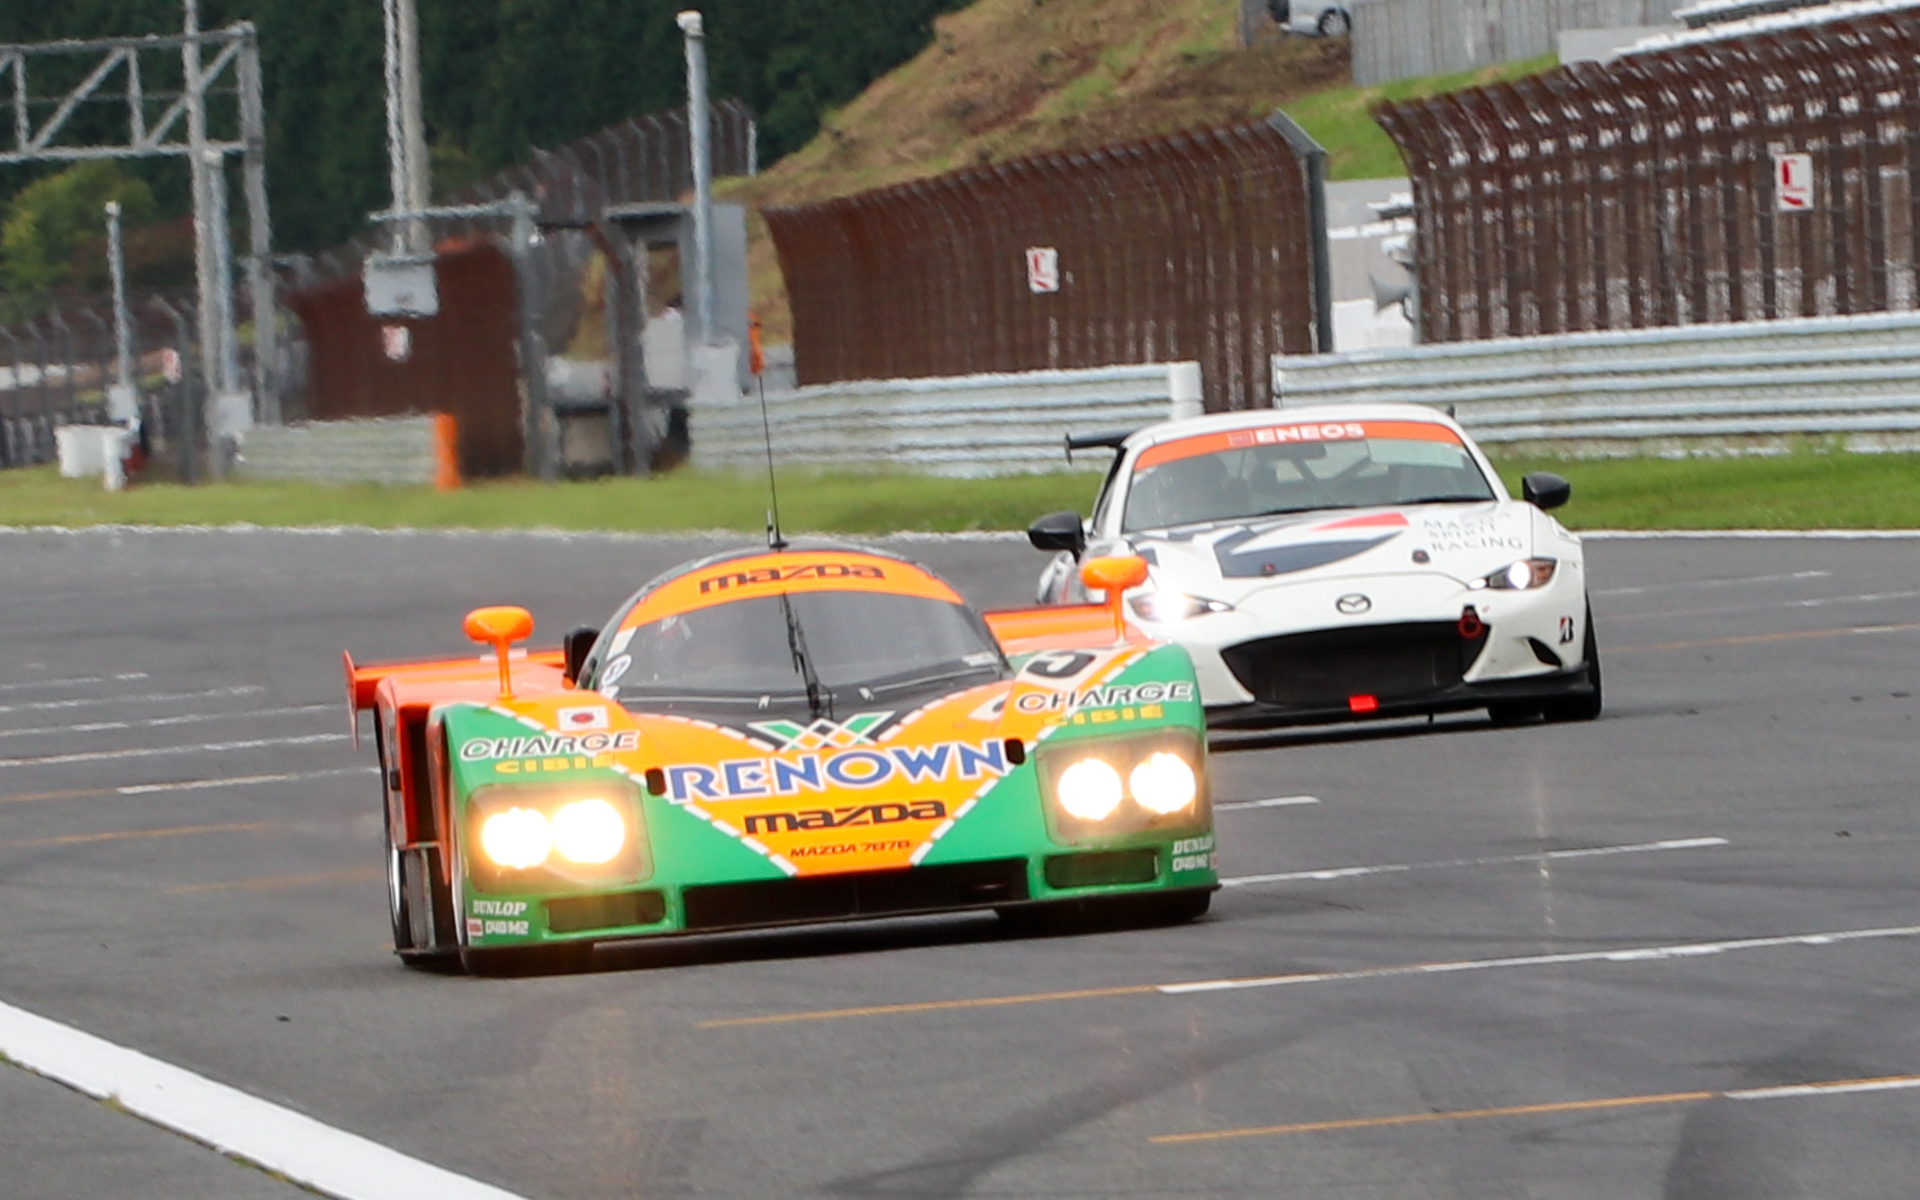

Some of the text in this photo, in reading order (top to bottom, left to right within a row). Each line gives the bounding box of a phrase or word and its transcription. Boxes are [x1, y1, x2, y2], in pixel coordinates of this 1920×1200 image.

[1255, 423, 1365, 443] ENEOS
[1431, 536, 1524, 552] RACING
[1016, 681, 1193, 712] CHARGE
[461, 730, 640, 760] CHARGE
[667, 739, 1007, 804] RENOWN
[789, 845, 857, 857] MAZDA
[473, 900, 527, 916] DUNLOP
